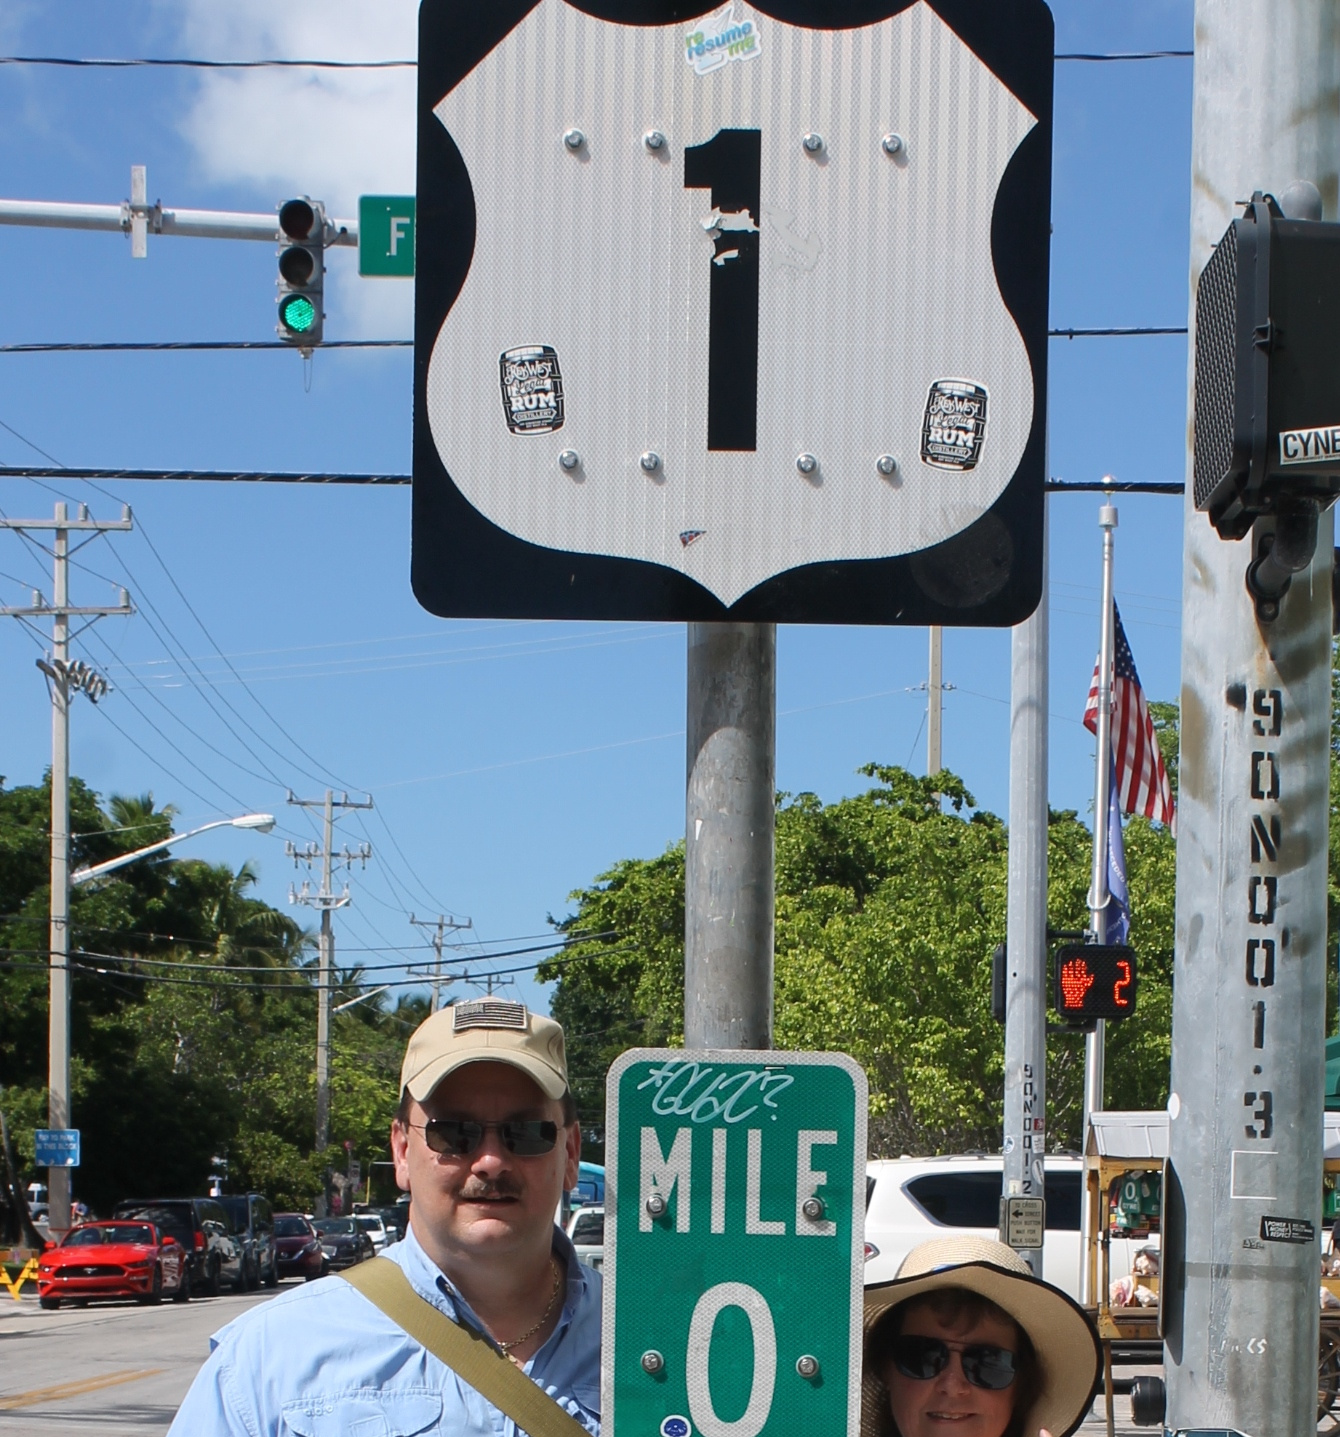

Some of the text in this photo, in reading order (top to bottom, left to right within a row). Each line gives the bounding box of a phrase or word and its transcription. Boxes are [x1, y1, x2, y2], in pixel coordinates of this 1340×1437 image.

[688, 22, 752, 60] resume
[728, 35, 755, 57] me
[684, 129, 761, 452] 1
[510, 392, 557, 412] RUM
[928, 427, 975, 448] RUM
[1114, 961, 1130, 1005] 2
[638, 1126, 838, 1237] MILE
